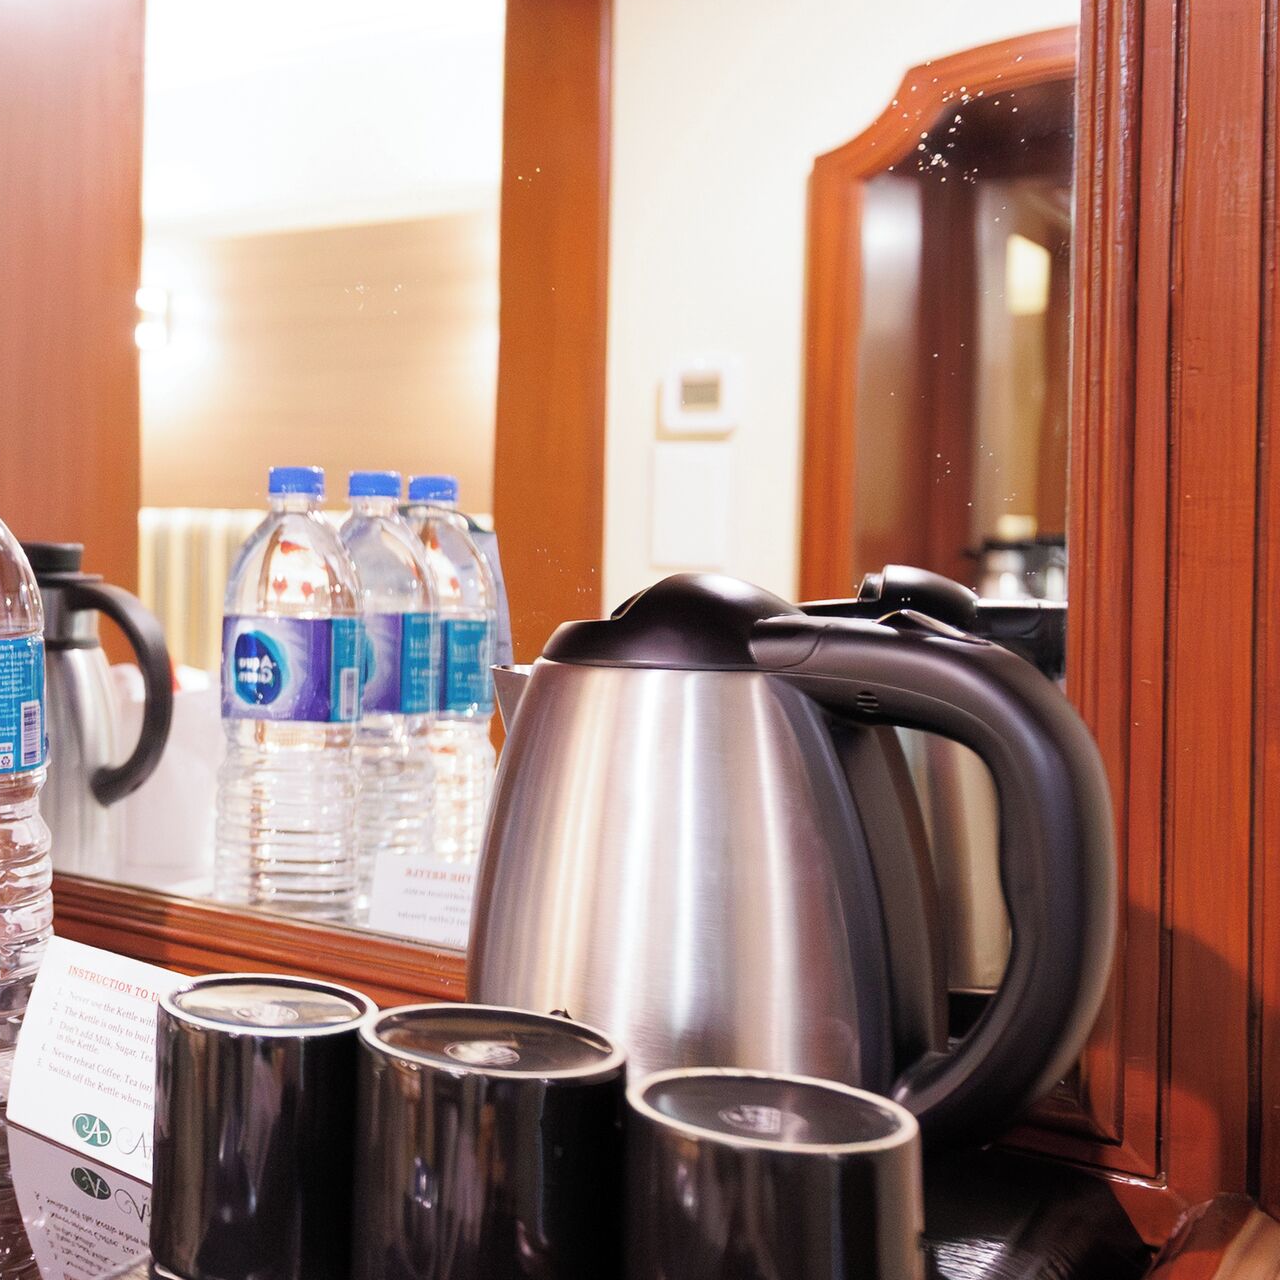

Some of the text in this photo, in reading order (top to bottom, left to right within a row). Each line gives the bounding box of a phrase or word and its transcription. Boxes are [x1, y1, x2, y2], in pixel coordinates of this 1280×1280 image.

[68, 965, 133, 994] INSTRUCTION
[135, 986, 149, 1000] TO
[64, 1005, 79, 1018] The
[78, 1009, 100, 1026] Kettle
[107, 1021, 125, 1036] only
[103, 1002, 116, 1014] the
[115, 1006, 139, 1024] Kettle
[139, 1015, 156, 1028] with
[52, 1046, 74, 1062] Never
[124, 1074, 139, 1088] Tea
[140, 1050, 154, 1063] Tea
[48, 1062, 72, 1079] Switch
[72, 1071, 85, 1084] off
[84, 1076, 97, 1089] the
[97, 1081, 120, 1098] Kettle
[120, 1091, 142, 1108] when
